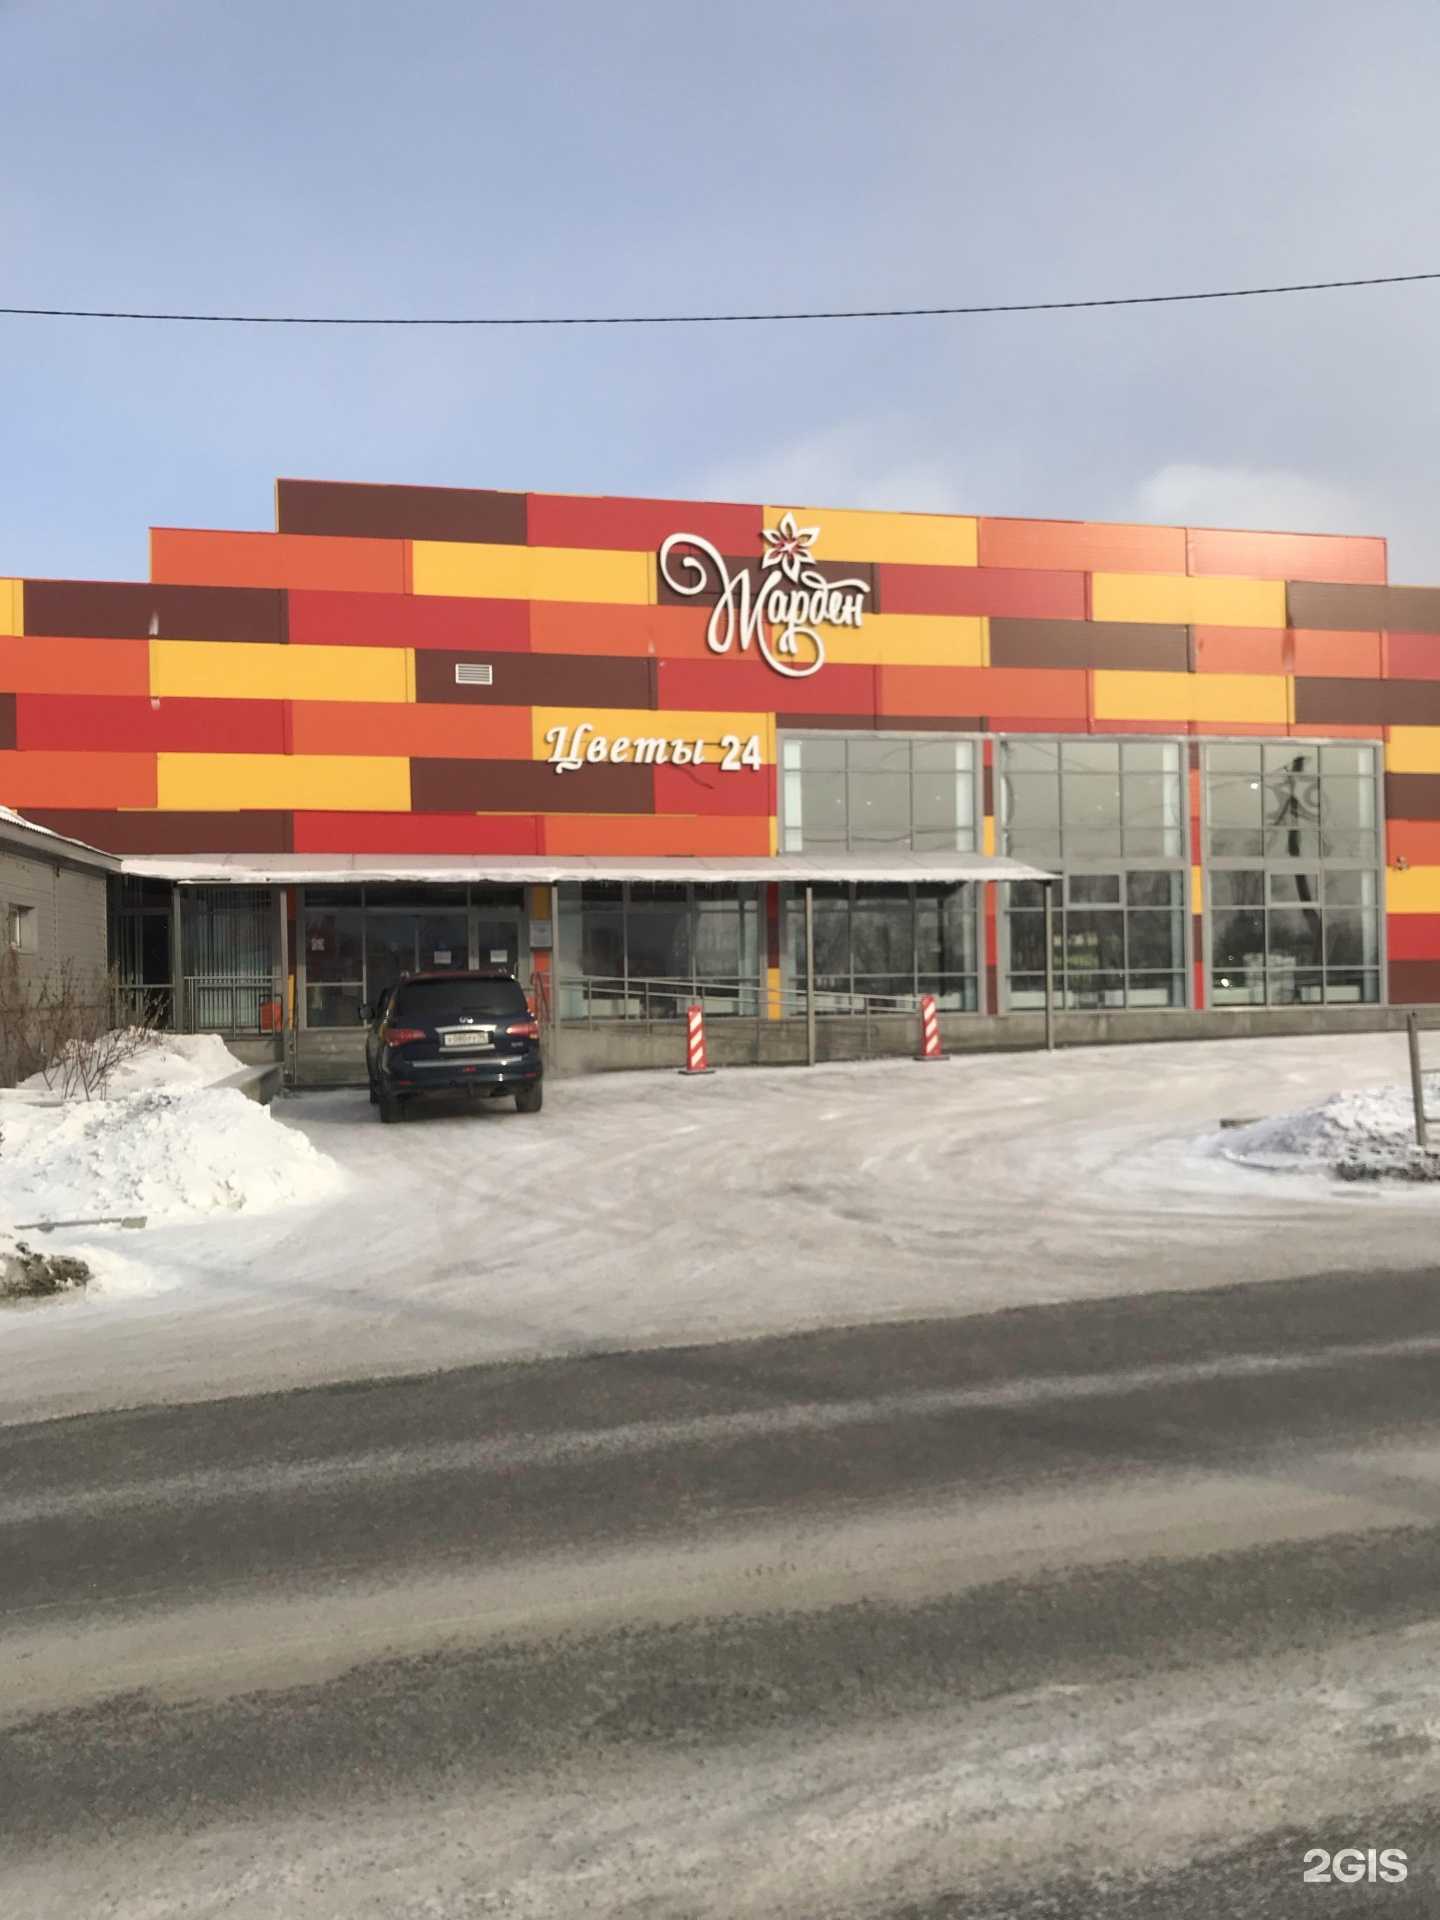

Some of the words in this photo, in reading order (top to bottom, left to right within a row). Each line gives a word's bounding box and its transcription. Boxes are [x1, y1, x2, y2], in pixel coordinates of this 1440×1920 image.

[659, 532, 871, 677] Жарден
[545, 723, 705, 774] Цветы
[720, 735, 761, 771] 24
